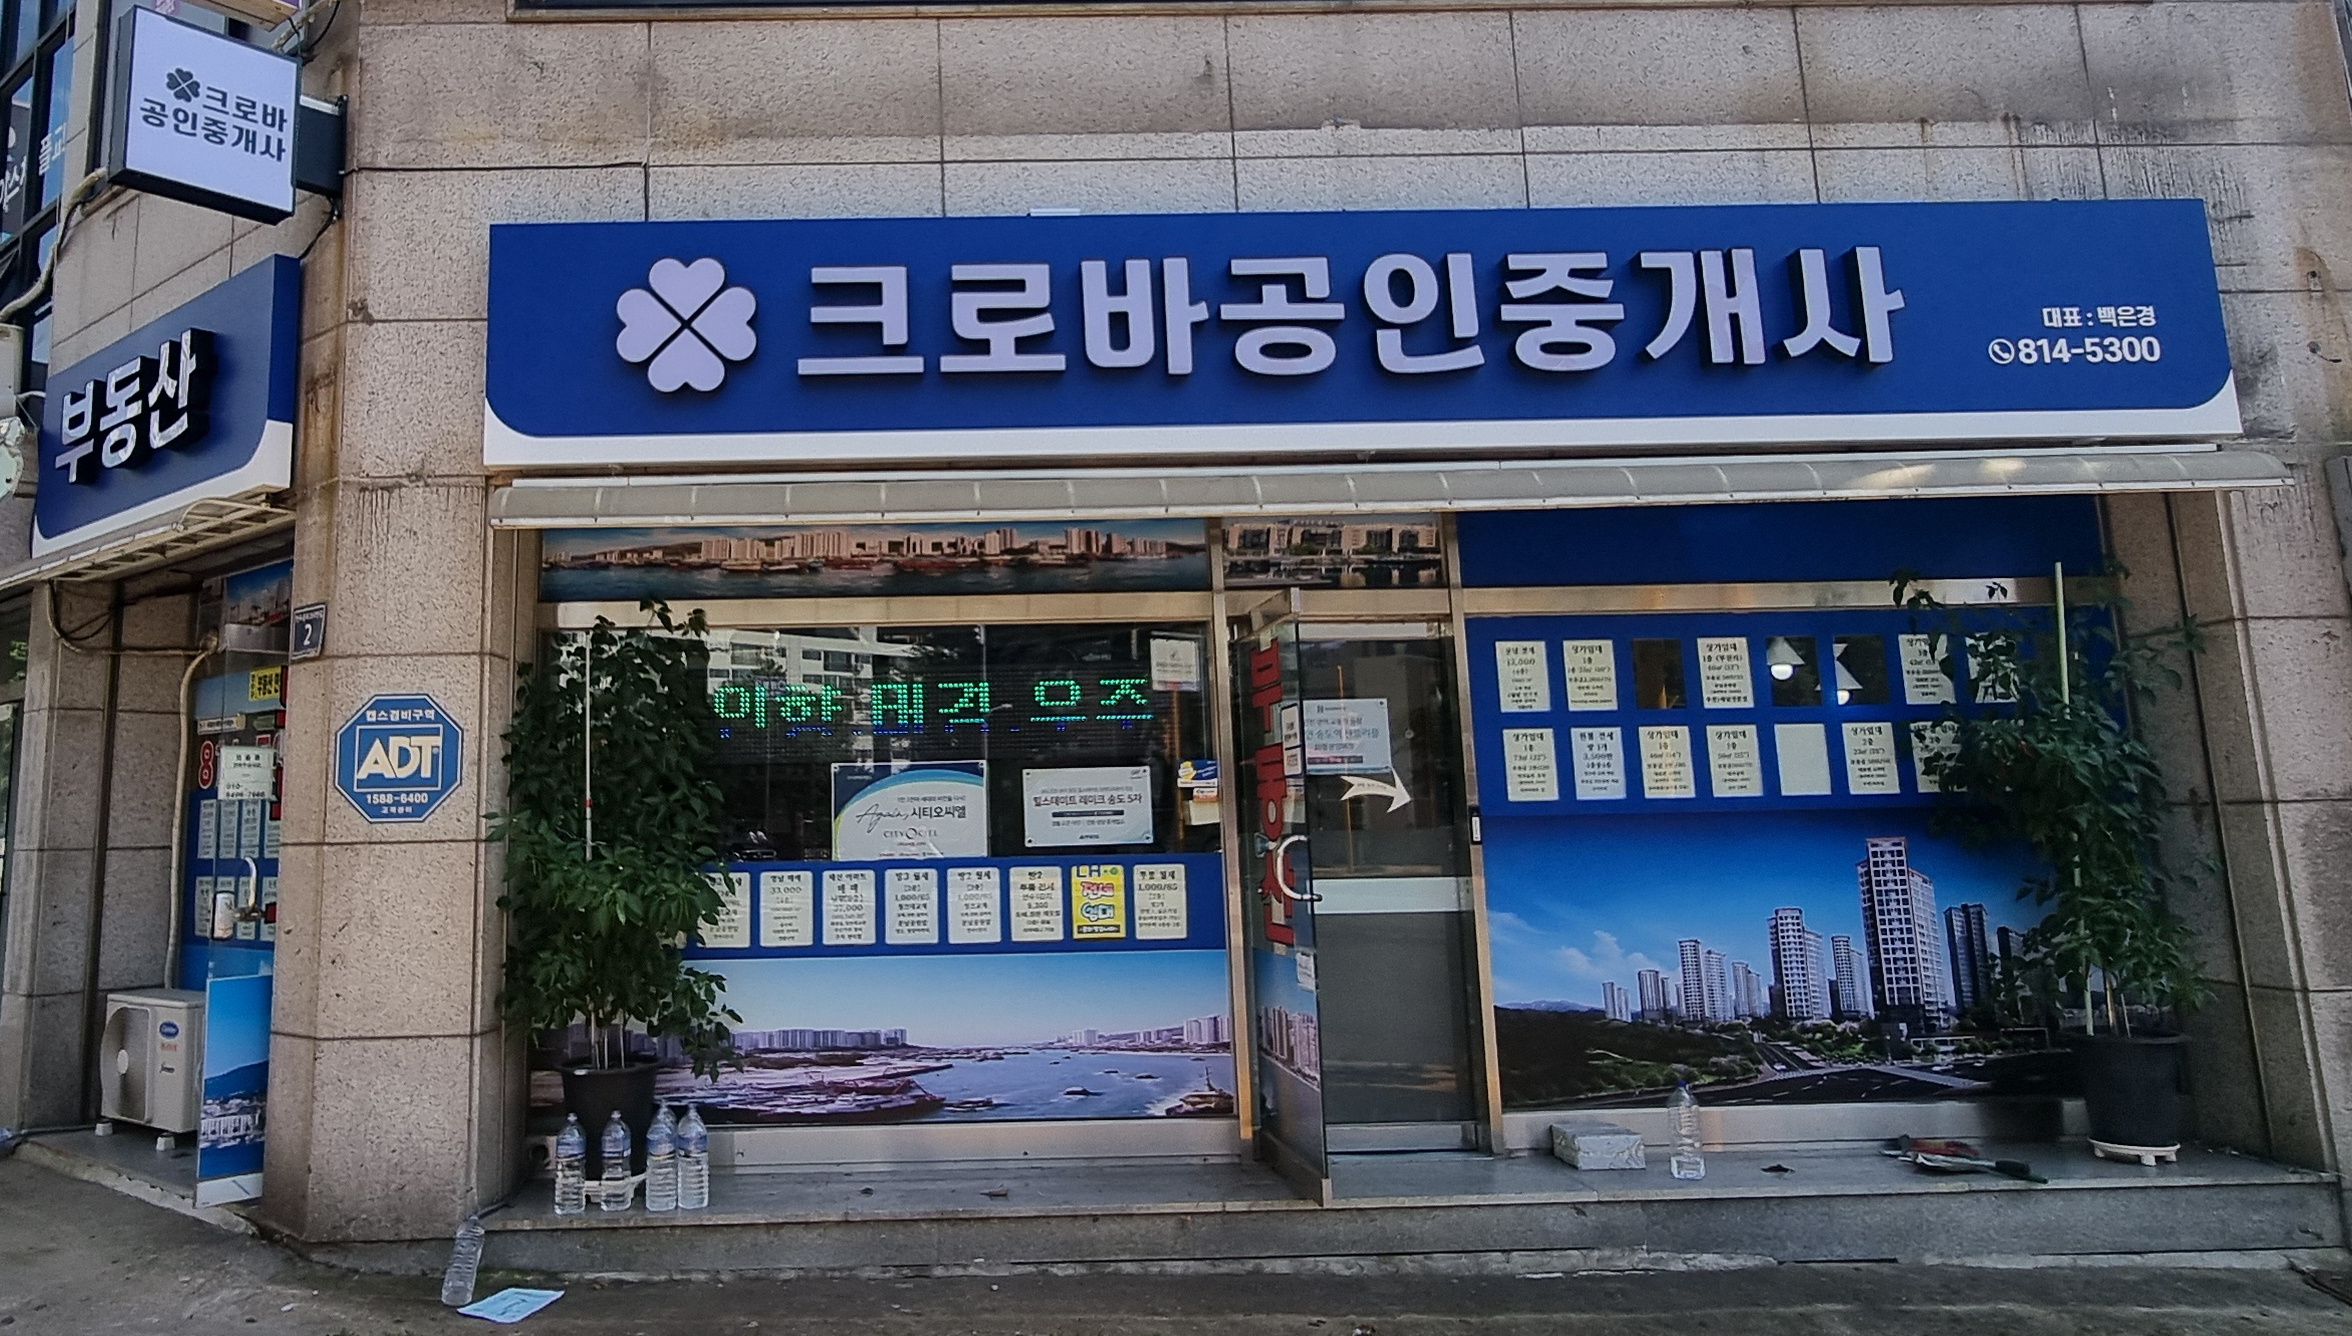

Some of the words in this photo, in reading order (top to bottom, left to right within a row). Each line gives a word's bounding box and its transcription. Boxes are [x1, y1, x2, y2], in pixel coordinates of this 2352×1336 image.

[203, 86, 287, 132] 크로바
[140, 98, 286, 162] 공인중개사
[2042, 307, 2082, 327] 대표
[2096, 305, 2157, 327] 백은경
[2017, 336, 2161, 364] 814-5300
[55, 328, 197, 484] 부동산
[303, 623, 312, 646] 2
[1706, 643, 1737, 652] 상가임대
[366, 708, 435, 723] 캡스경비구역
[356, 735, 441, 779] ADT
[367, 792, 428, 804] 1588-6400
[1033, 795, 1077, 807] 힐스테이트
[1079, 793, 1105, 805] 레이크
[1108, 794, 1125, 805] 송도
[1127, 792, 1142, 804] 5차
[911, 805, 966, 819] 시티오씨엘
